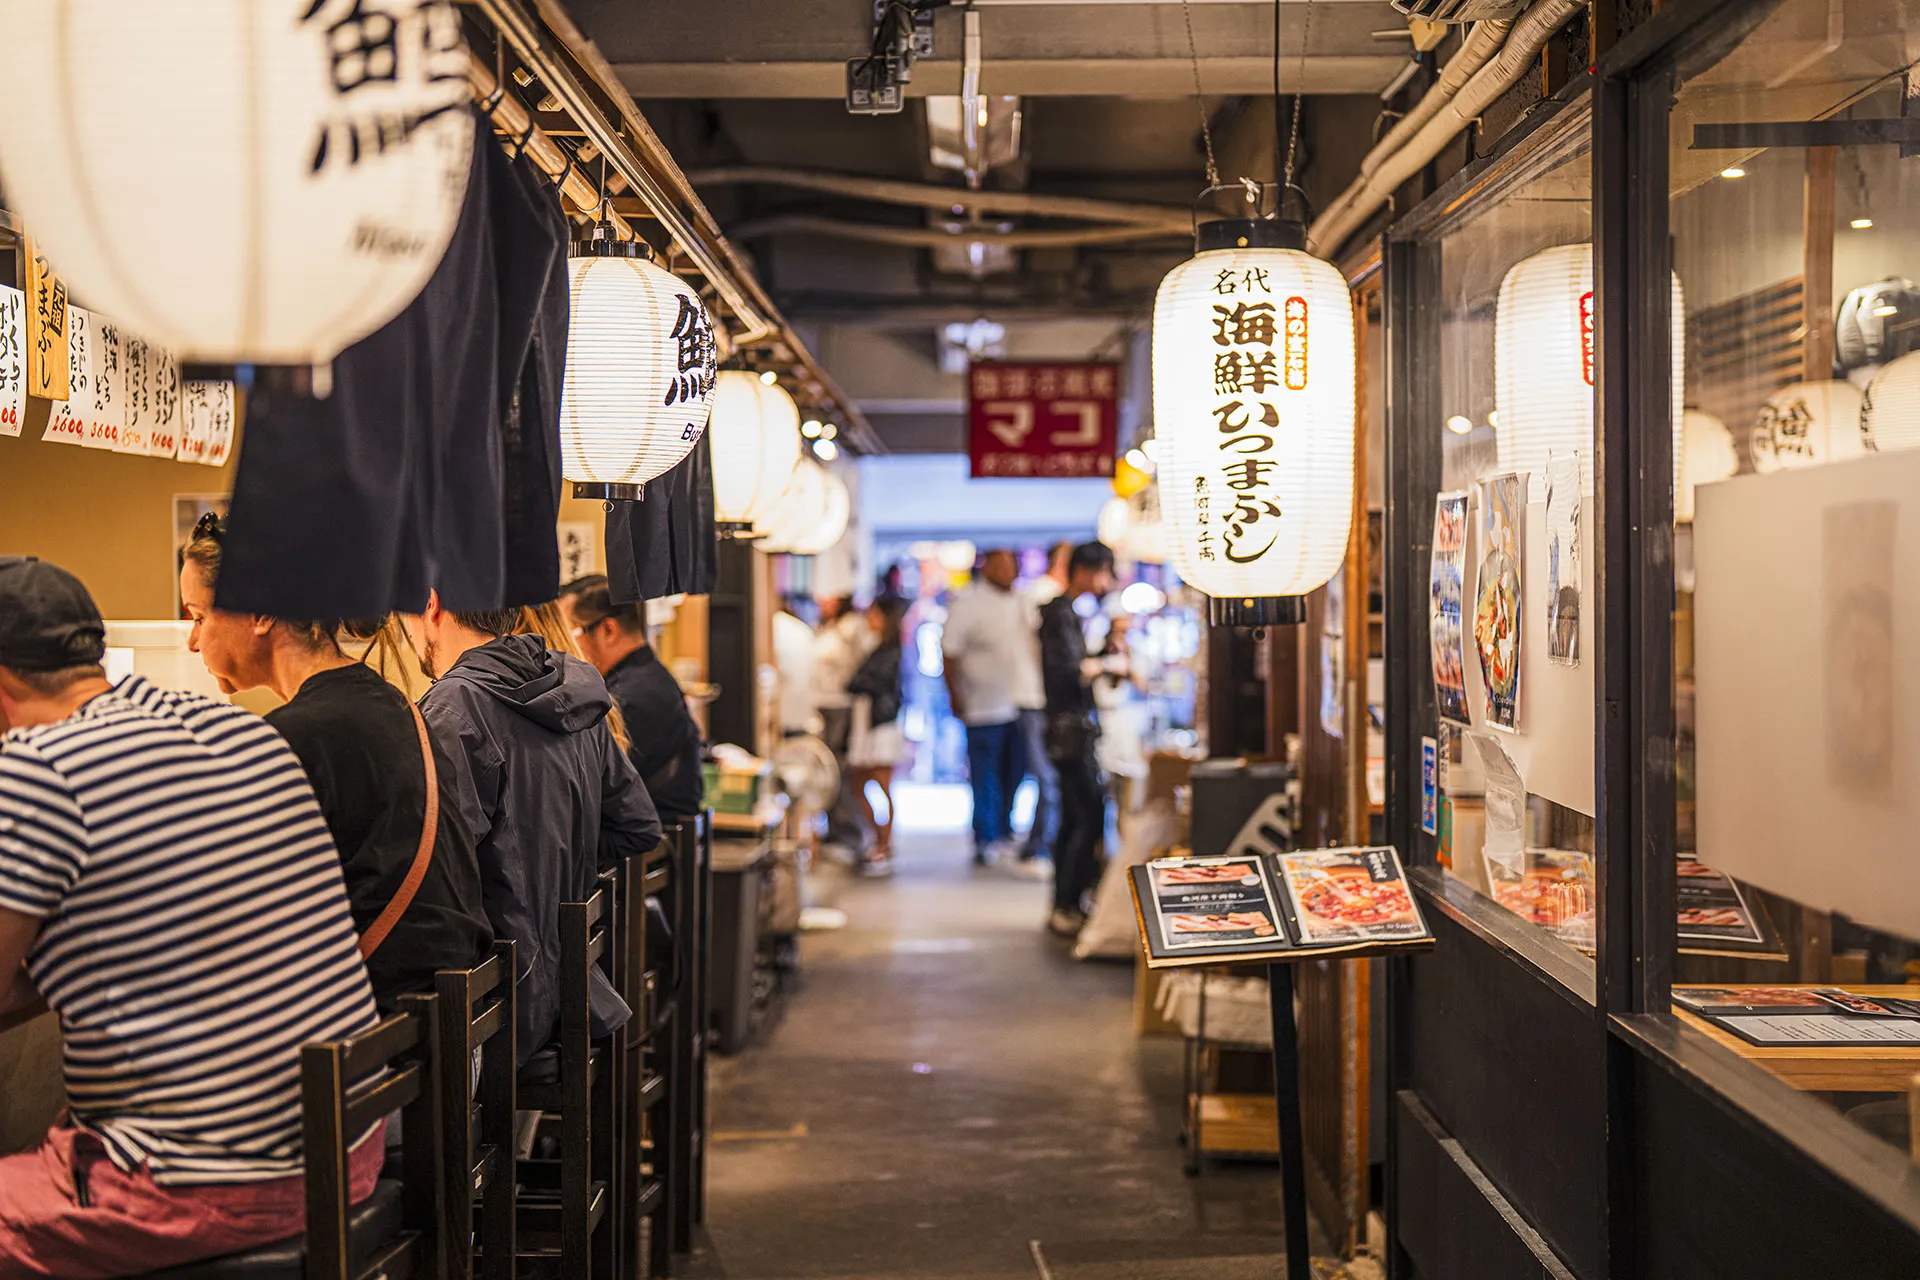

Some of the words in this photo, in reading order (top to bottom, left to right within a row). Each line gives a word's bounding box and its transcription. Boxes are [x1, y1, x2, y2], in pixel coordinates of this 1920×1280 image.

[35, 254, 52, 389] つまぶし
[1211, 267, 1272, 295] 名代
[982, 401, 1100, 447] マコ
[1212, 302, 1282, 564] 海鮮ひつまぶし
